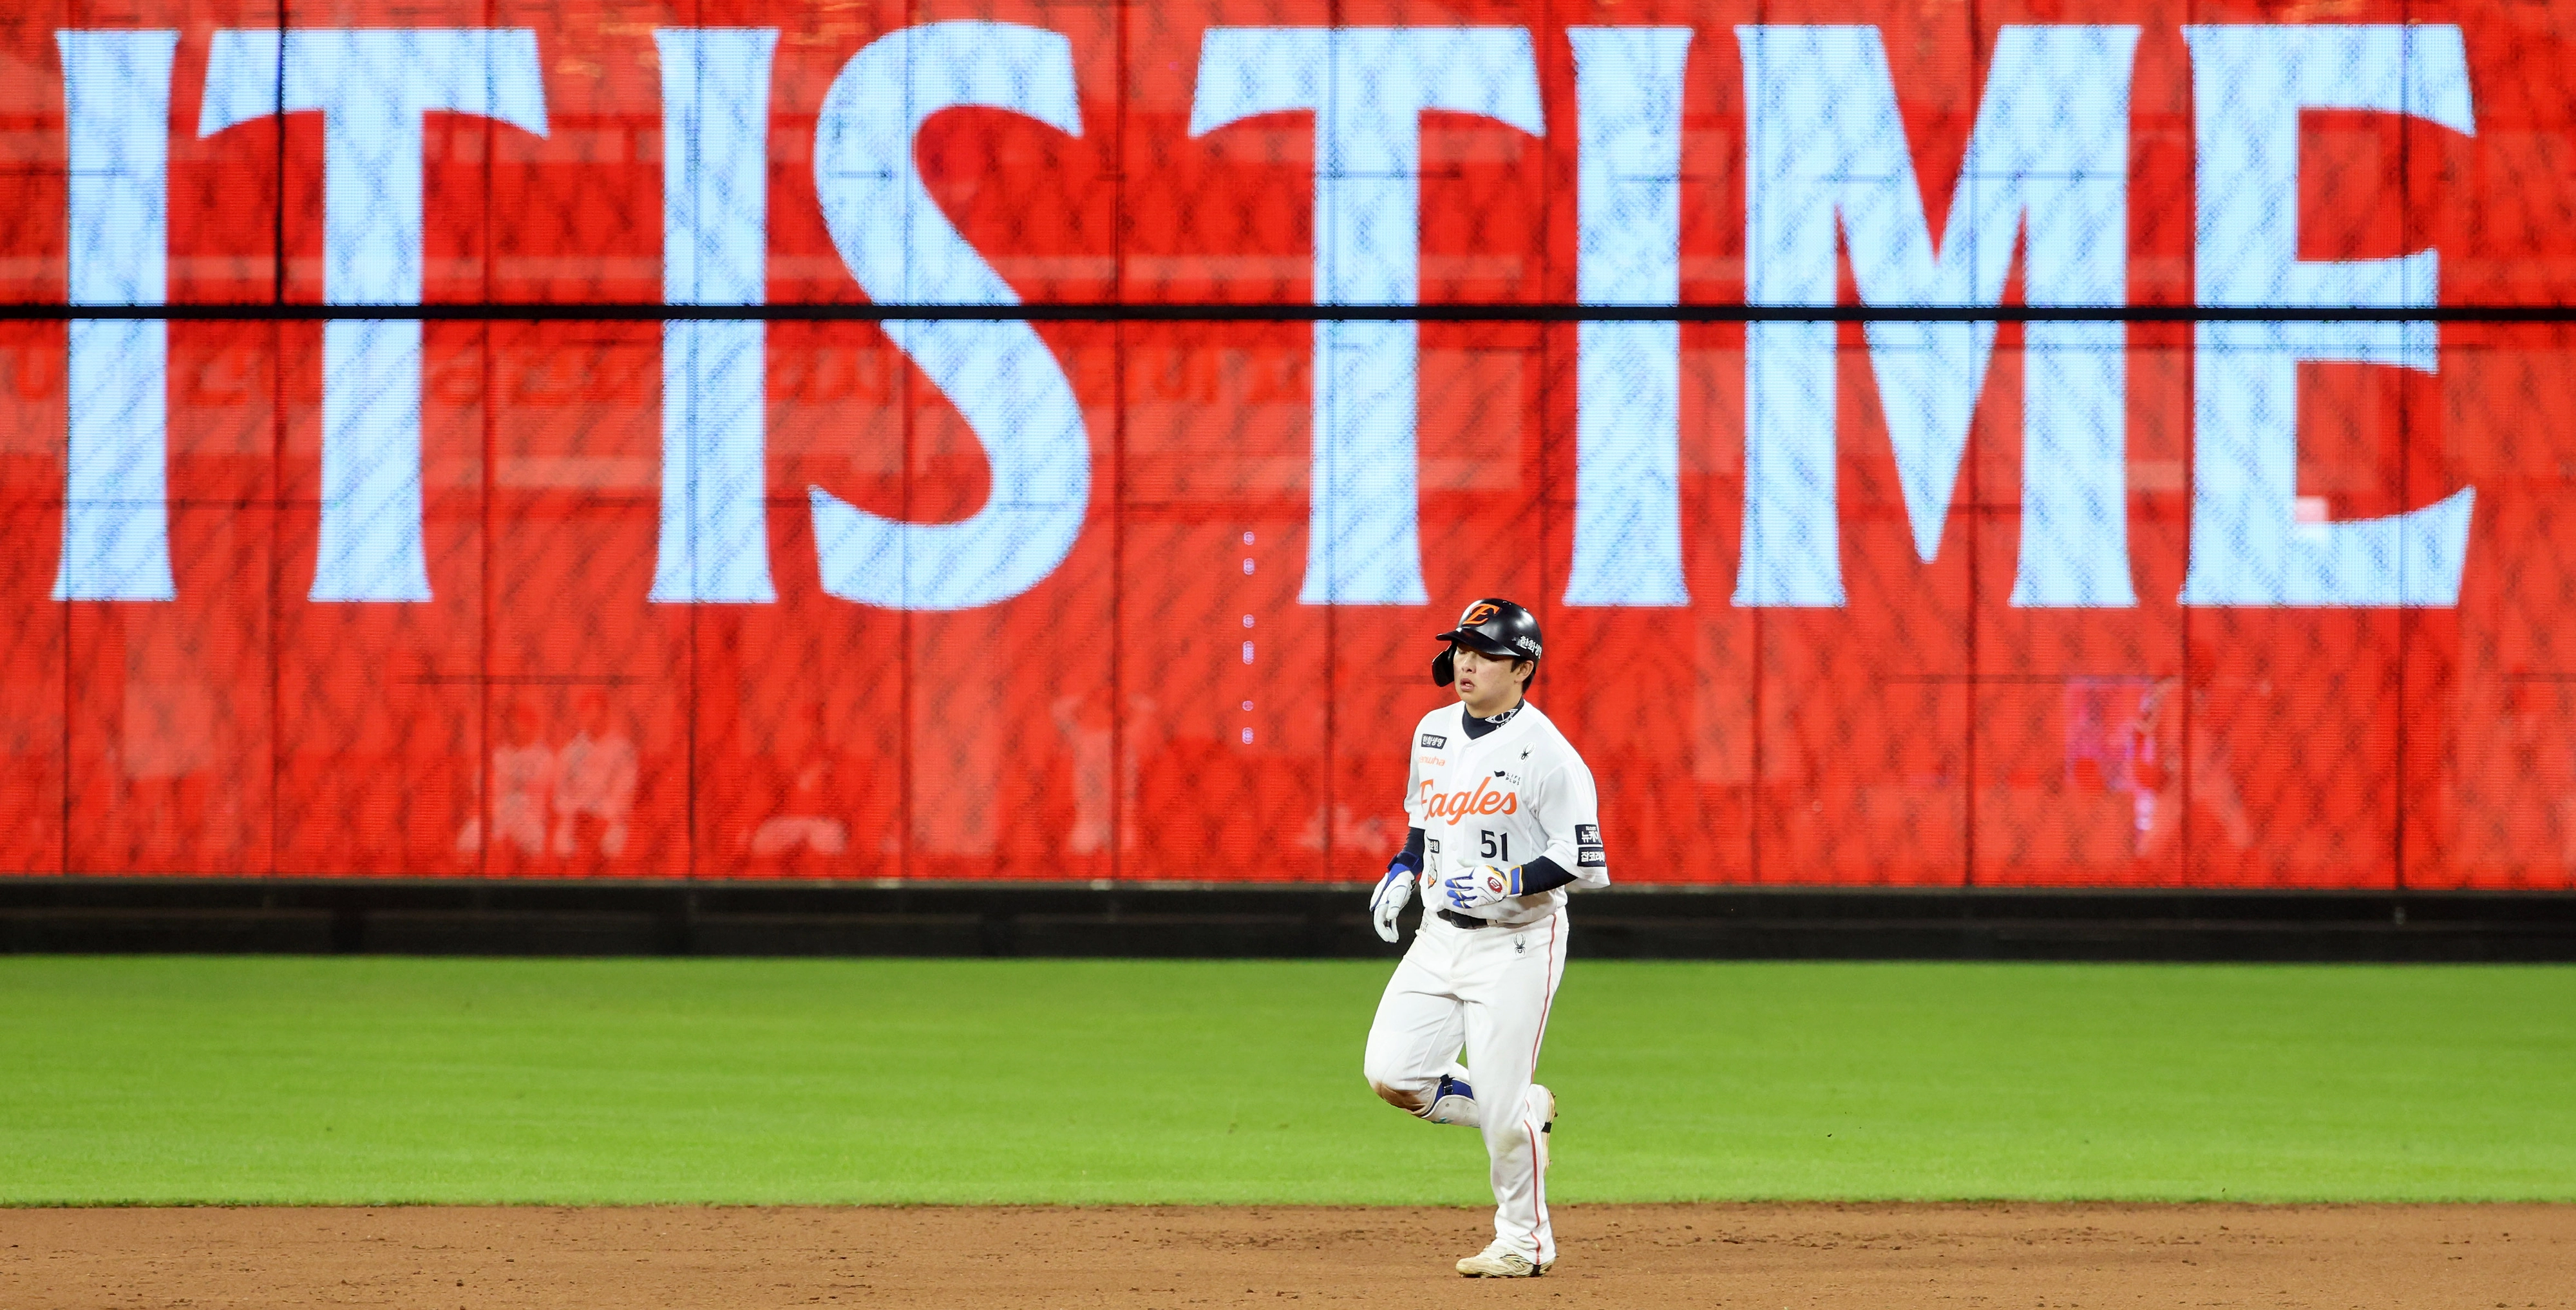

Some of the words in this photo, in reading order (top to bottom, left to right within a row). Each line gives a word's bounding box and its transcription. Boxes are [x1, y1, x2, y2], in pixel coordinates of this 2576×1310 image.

[52, 28, 548, 603] IT
[648, 19, 1090, 611] IS
[1189, 23, 2475, 608] TIME
[1422, 735, 1444, 747] 한화생명
[1419, 755, 1446, 767] anwha
[1505, 776, 1519, 786] PLUS
[1419, 776, 1517, 826] Eagles
[1480, 829, 1509, 862] 51
